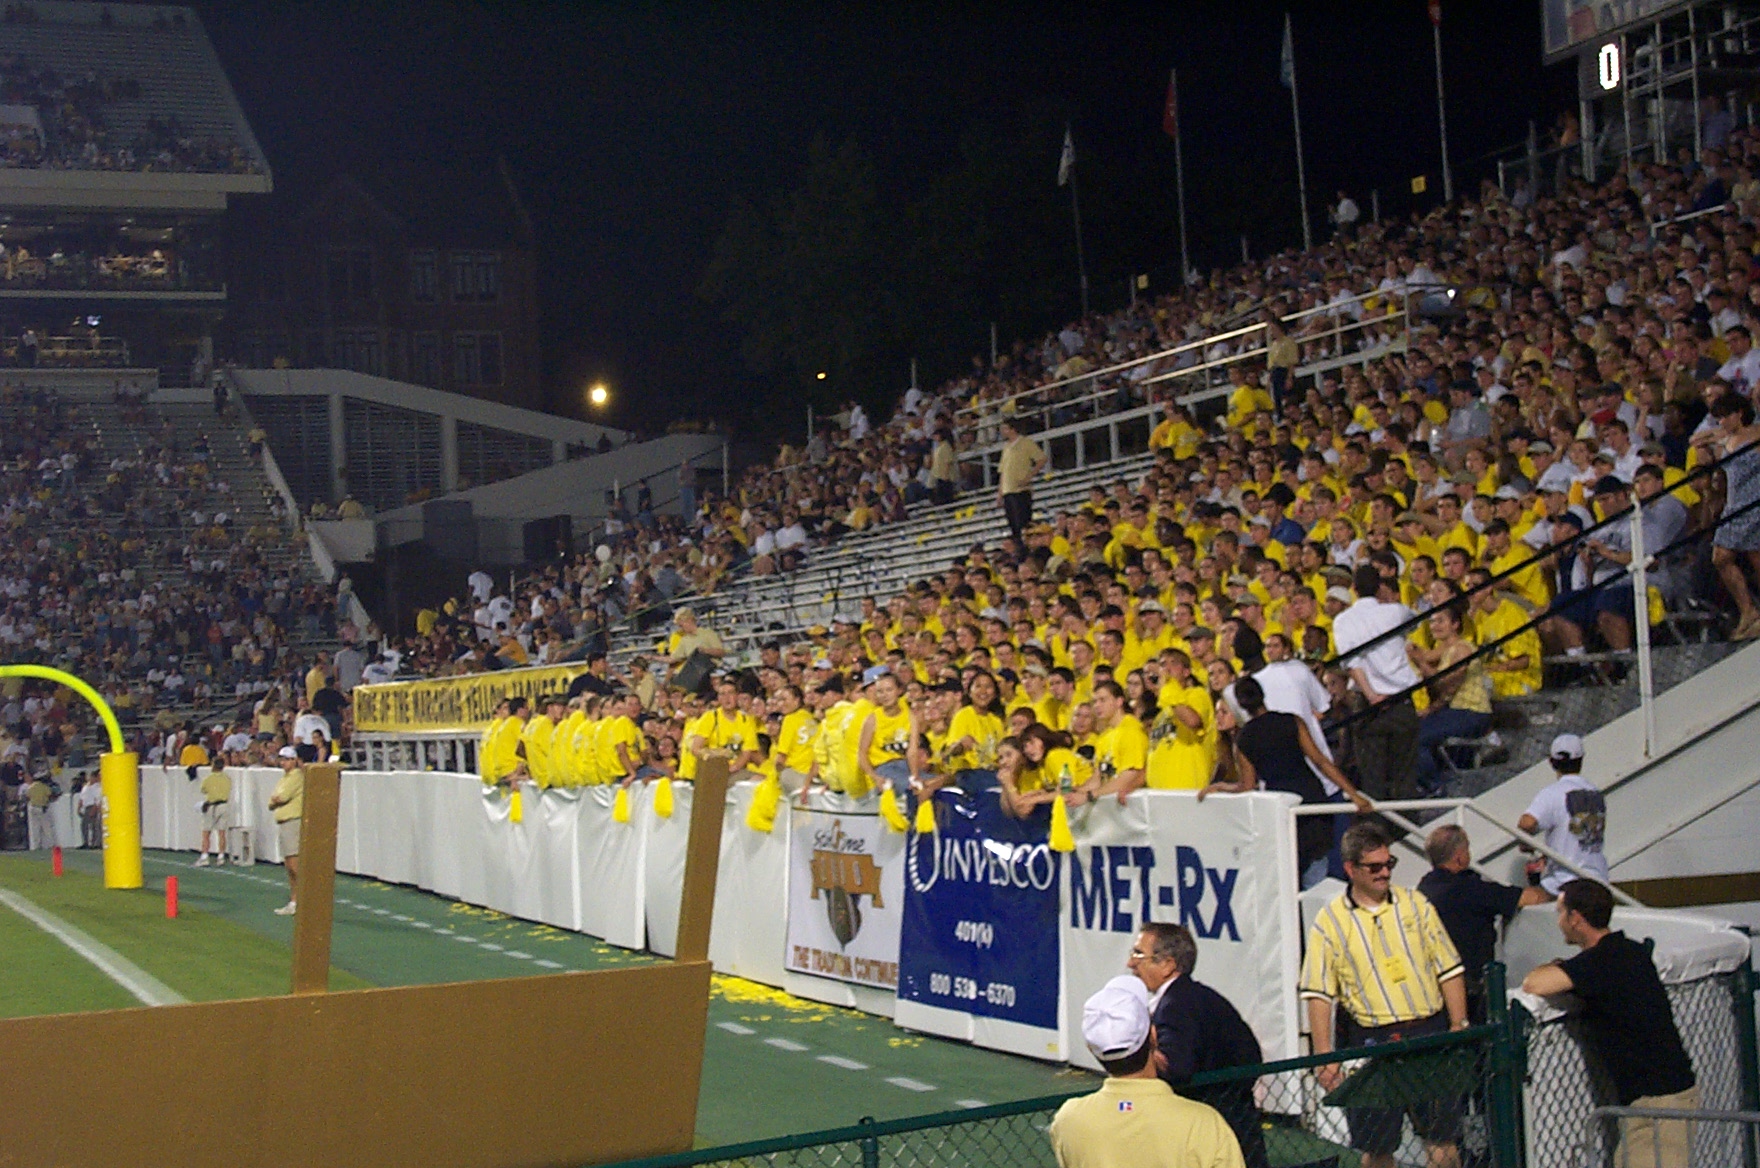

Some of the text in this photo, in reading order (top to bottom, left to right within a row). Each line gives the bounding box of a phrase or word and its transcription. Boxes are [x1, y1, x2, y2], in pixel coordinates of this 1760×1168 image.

[943, 837, 1055, 890] INVESCO
[793, 944, 810, 969] THE
[929, 972, 949, 996] 800
